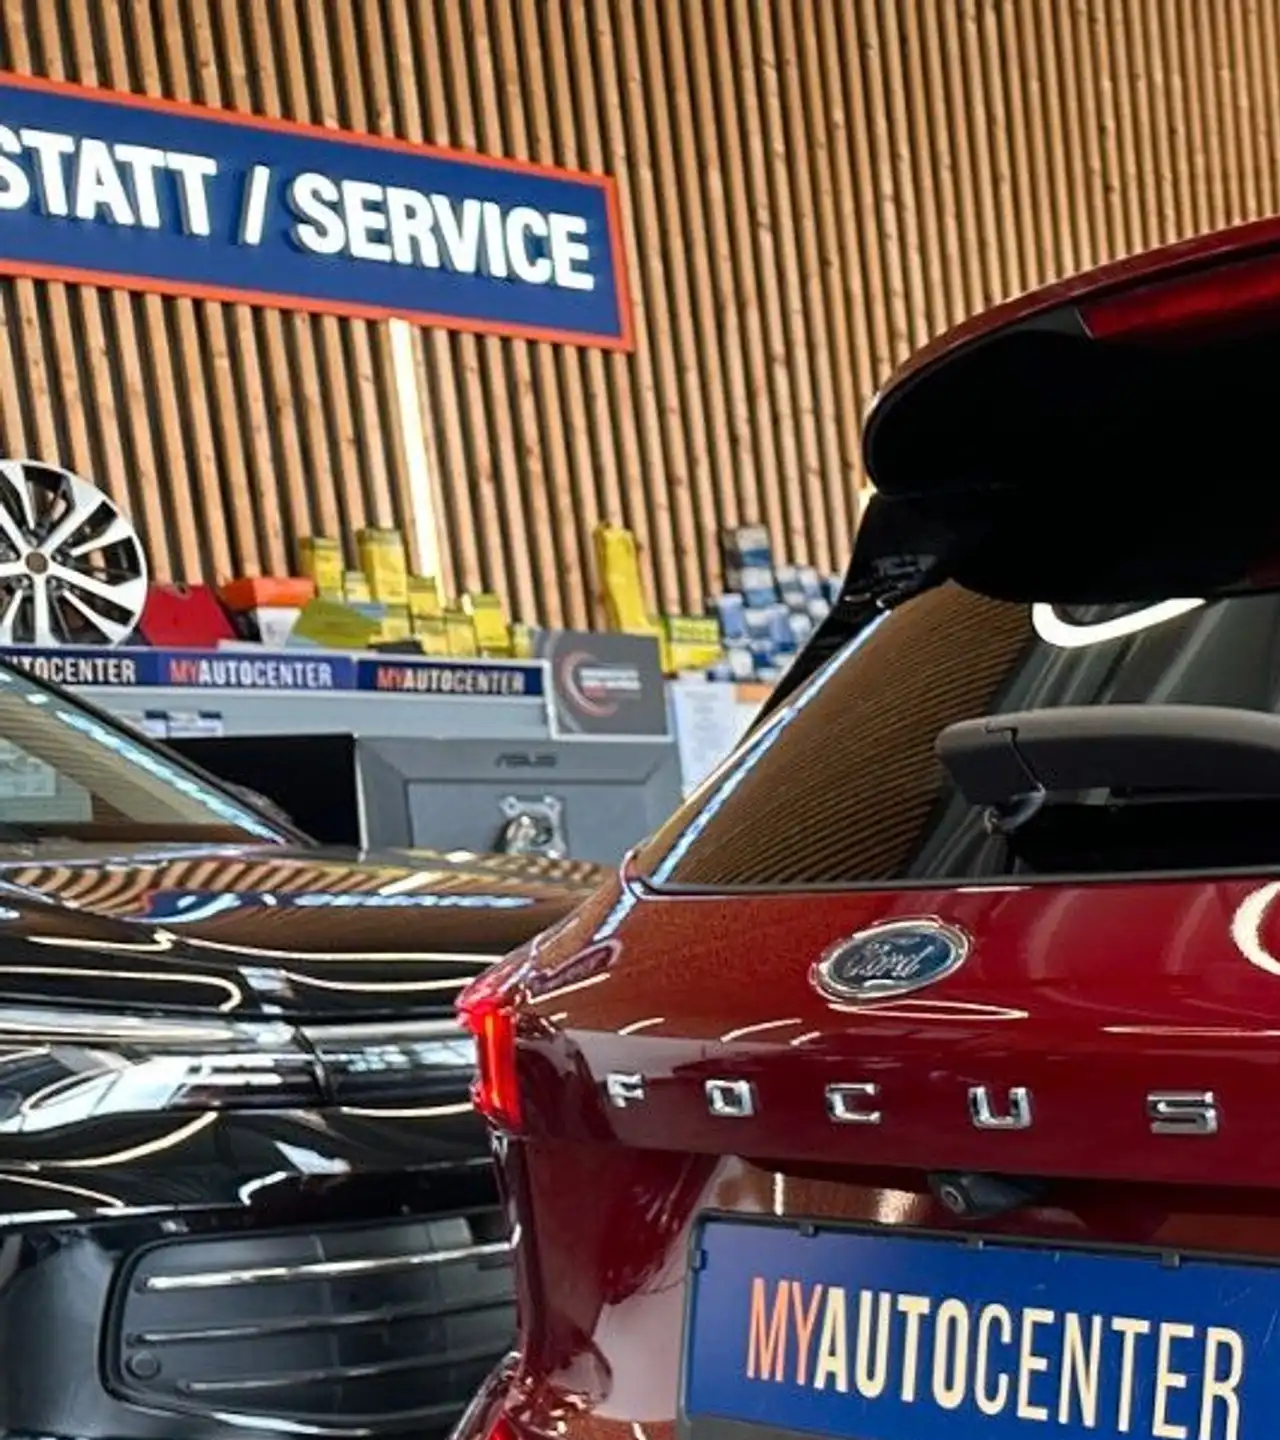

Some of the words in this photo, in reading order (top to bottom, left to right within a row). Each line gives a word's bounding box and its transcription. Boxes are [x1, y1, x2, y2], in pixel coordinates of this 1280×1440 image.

[241, 164, 271, 246] /
[291, 172, 595, 292] SERVICE
[169, 657, 333, 689] MYAUTOCENTER
[376, 665, 526, 695] MYAUTOCENTER
[842, 939, 937, 979] Ford
[604, 1071, 1219, 1136] FOCUS
